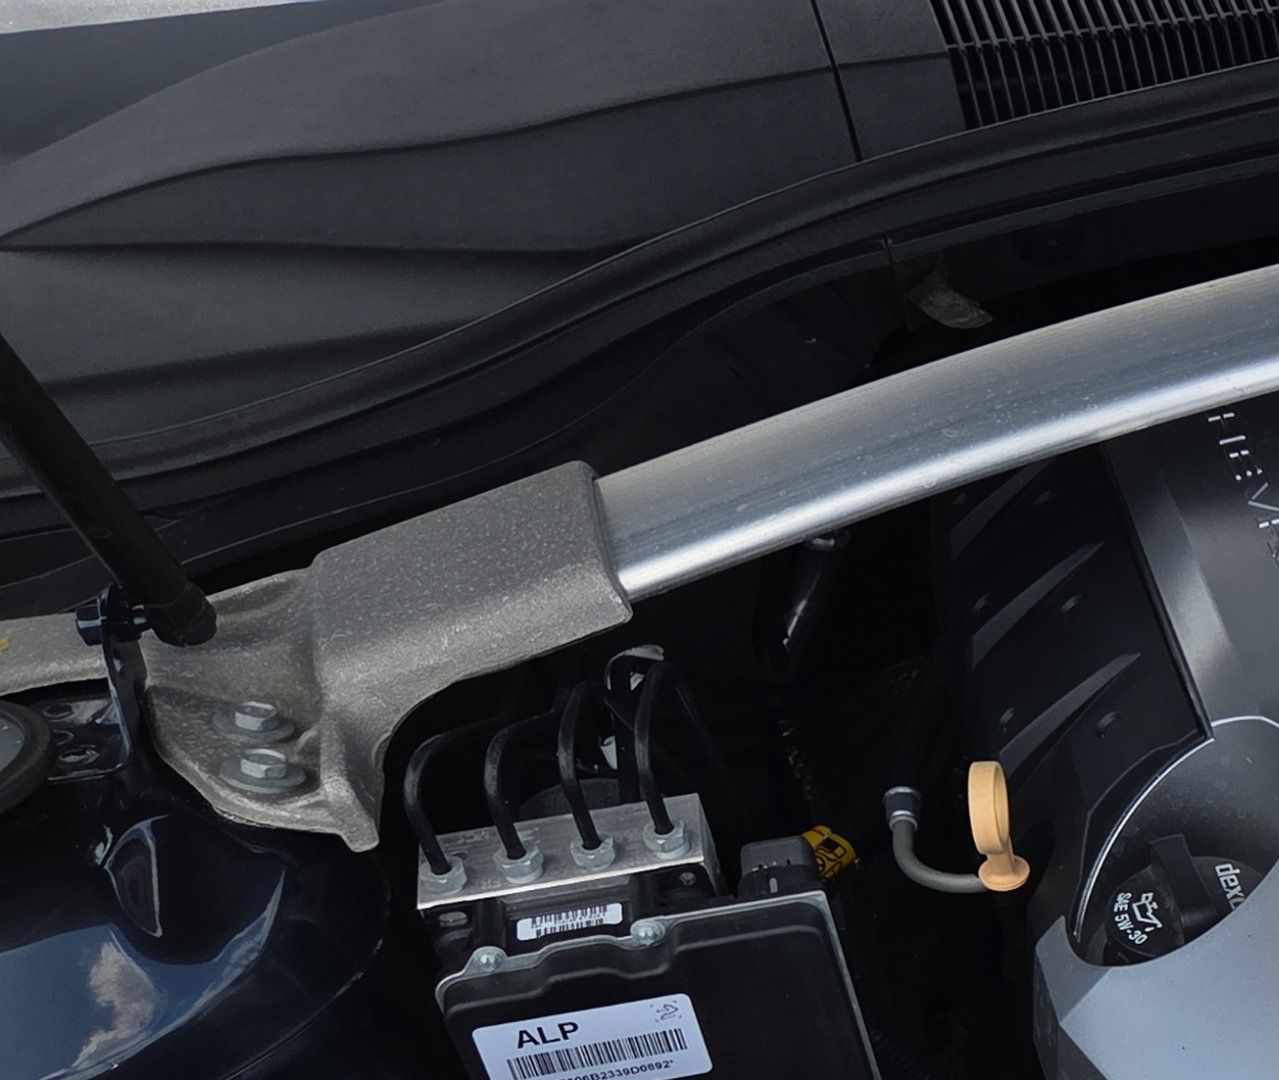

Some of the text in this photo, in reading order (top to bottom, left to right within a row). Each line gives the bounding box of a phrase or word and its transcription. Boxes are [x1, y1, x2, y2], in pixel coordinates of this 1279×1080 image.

[1113, 892, 1149, 945] SAE 5W-30
[516, 1021, 579, 1049] ALP
